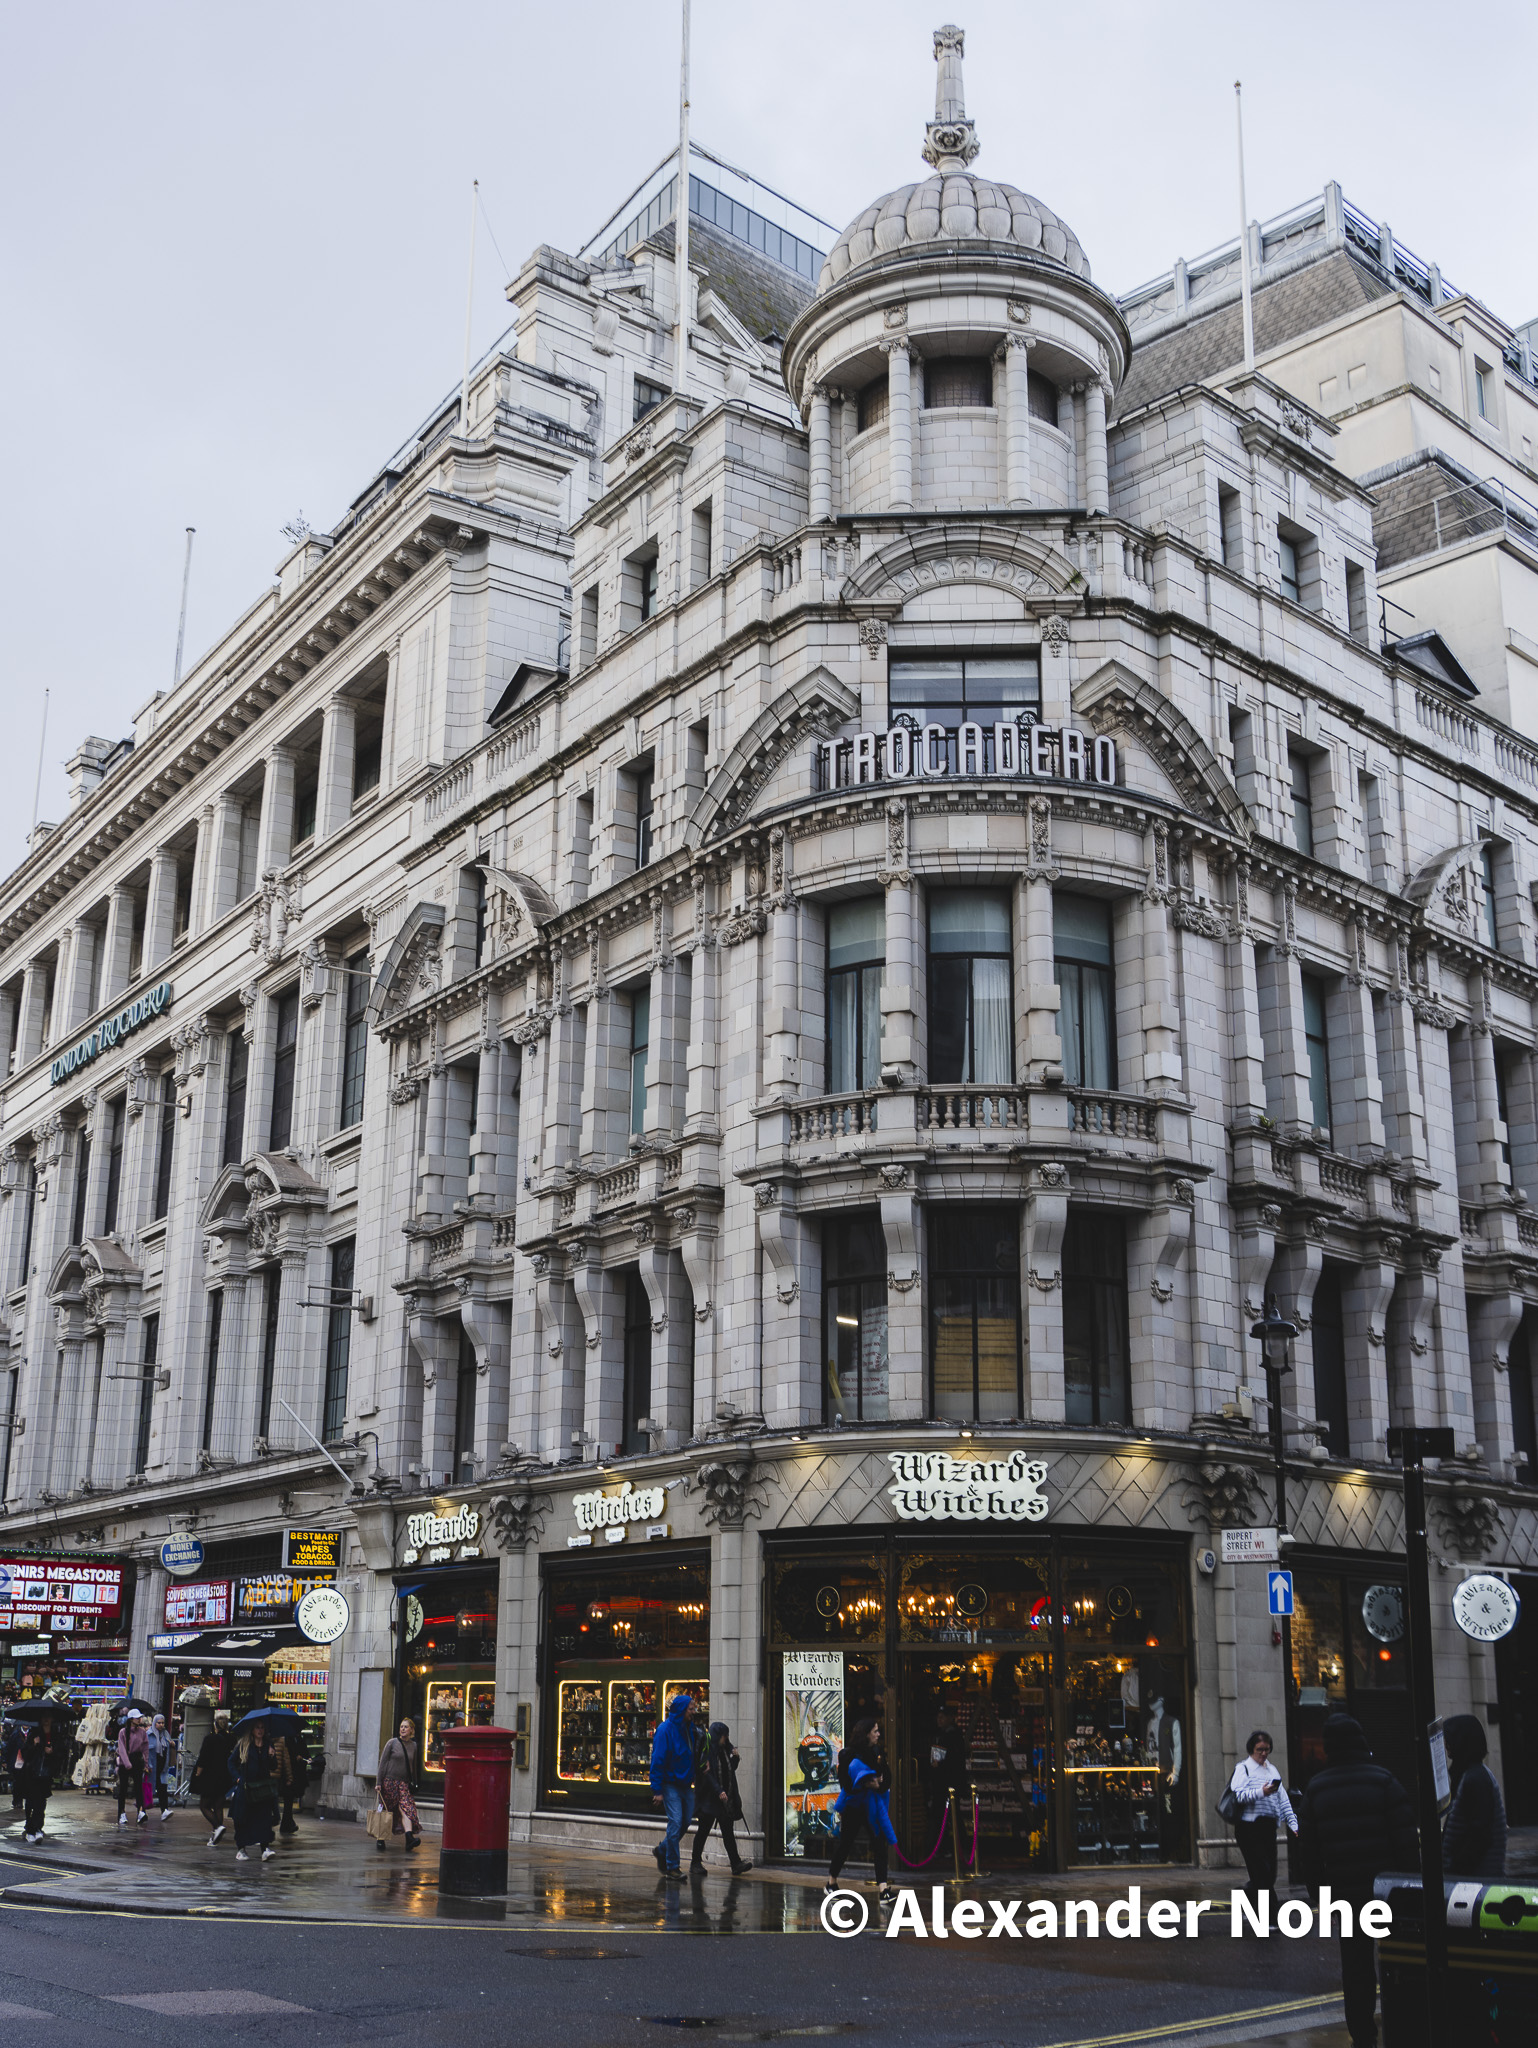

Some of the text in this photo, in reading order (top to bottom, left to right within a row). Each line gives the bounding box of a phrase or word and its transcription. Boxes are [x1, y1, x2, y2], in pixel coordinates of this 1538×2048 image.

[821, 721, 1117, 790] TROCADERO
[50, 982, 170, 1086] LONDON TROCADERO
[893, 1453, 1045, 1484] Wizards
[966, 1484, 978, 1497] &
[580, 1493, 652, 1523] Witches
[894, 1489, 1045, 1515] Witches
[410, 1507, 477, 1544] Wizards
[290, 1532, 339, 1541] BESTMART
[1226, 1531, 1253, 1541] RUPERT
[169, 1541, 194, 1552] MONEY
[299, 1544, 330, 1553] VAPES
[1226, 1540, 1265, 1550] STREET W1
[165, 1550, 201, 1562] EXCHANGE
[295, 1552, 333, 1560] TOBACCO
[0, 1564, 121, 1583] ENIRS MEGASTORE
[167, 1584, 227, 1601] SOUVENIRS MEGASTORE
[1461, 1583, 1510, 1606] Wizards
[16, 1603, 51, 1612] DISCOUNT
[69, 1605, 102, 1614] STUDENTS
[303, 1594, 341, 1612] Wizards
[1481, 1603, 1491, 1614] &
[319, 1610, 326, 1620] &
[304, 1620, 343, 1638] Witches
[1461, 1611, 1510, 1637] Witches
[156, 1635, 173, 1648] MONEY
[786, 1652, 841, 1664] Wizards
[164, 1666, 179, 1674] TOBACCO
[189, 1667, 202, 1675] CIGARS
[234, 1669, 252, 1678] E-LIQUIDS
[810, 1664, 818, 1674] &
[788, 1673, 841, 1687] Wonders
[803, 1736, 822, 1744] LONDON
